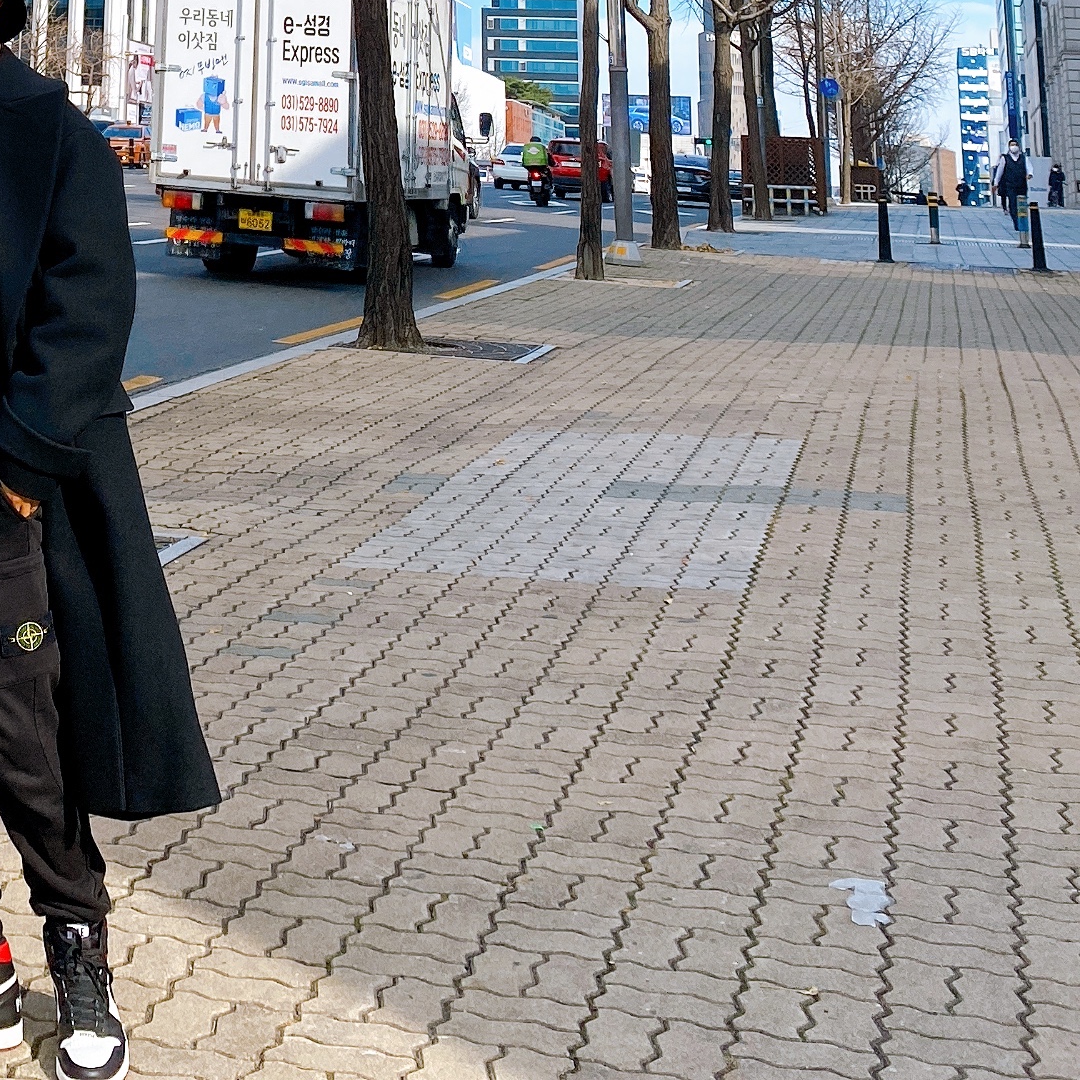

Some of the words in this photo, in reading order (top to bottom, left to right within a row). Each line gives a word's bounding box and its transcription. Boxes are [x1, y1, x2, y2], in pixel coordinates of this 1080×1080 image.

[179, 7, 234, 28] 우리동네
[283, 15, 331, 37] e-성경
[178, 30, 218, 51] 이삿짐
[282, 39, 340, 67] Express
[281, 94, 339, 113] 031)529-8890
[281, 115, 339, 134] 031)575-7924
